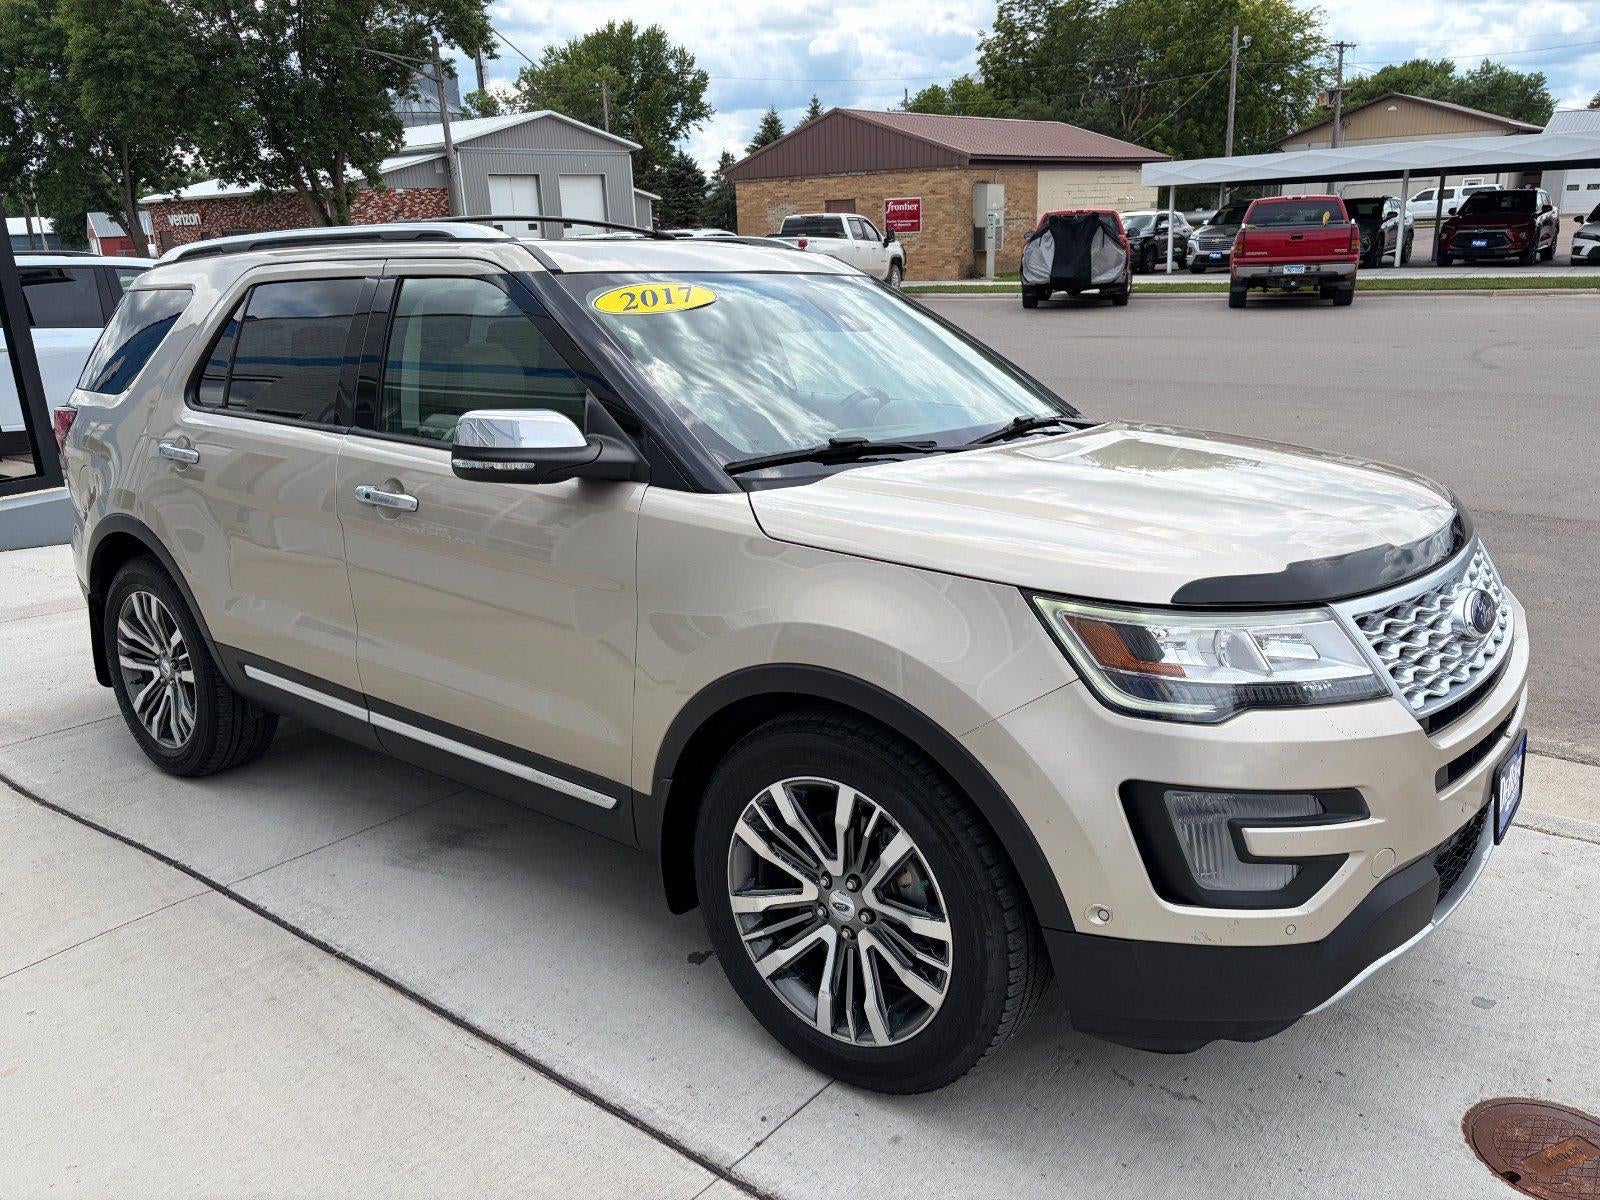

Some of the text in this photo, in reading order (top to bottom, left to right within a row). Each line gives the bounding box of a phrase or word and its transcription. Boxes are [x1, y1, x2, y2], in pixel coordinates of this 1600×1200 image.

[886, 202, 919, 214] frontier
[167, 212, 202, 227] verizon
[619, 286, 692, 311] 2017
